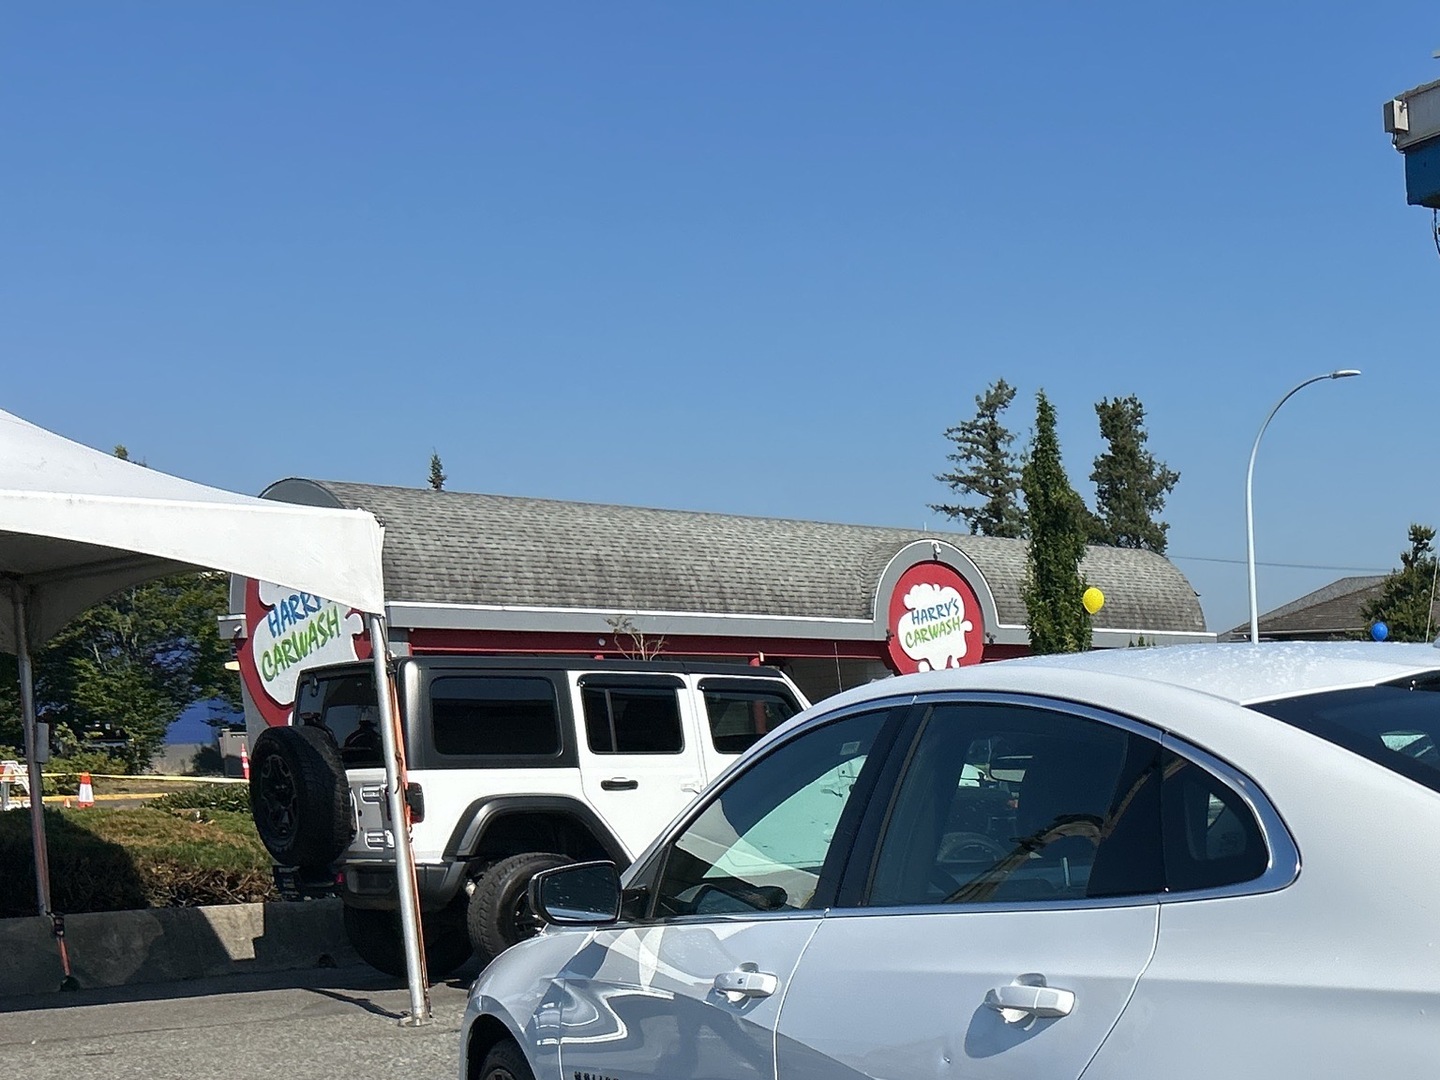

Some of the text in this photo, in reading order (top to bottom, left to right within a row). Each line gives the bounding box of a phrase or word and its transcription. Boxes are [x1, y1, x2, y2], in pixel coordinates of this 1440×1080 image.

[911, 598, 960, 625] HARRY'S
[261, 606, 341, 682] CARWASH
[905, 616, 961, 648] CARWASH
